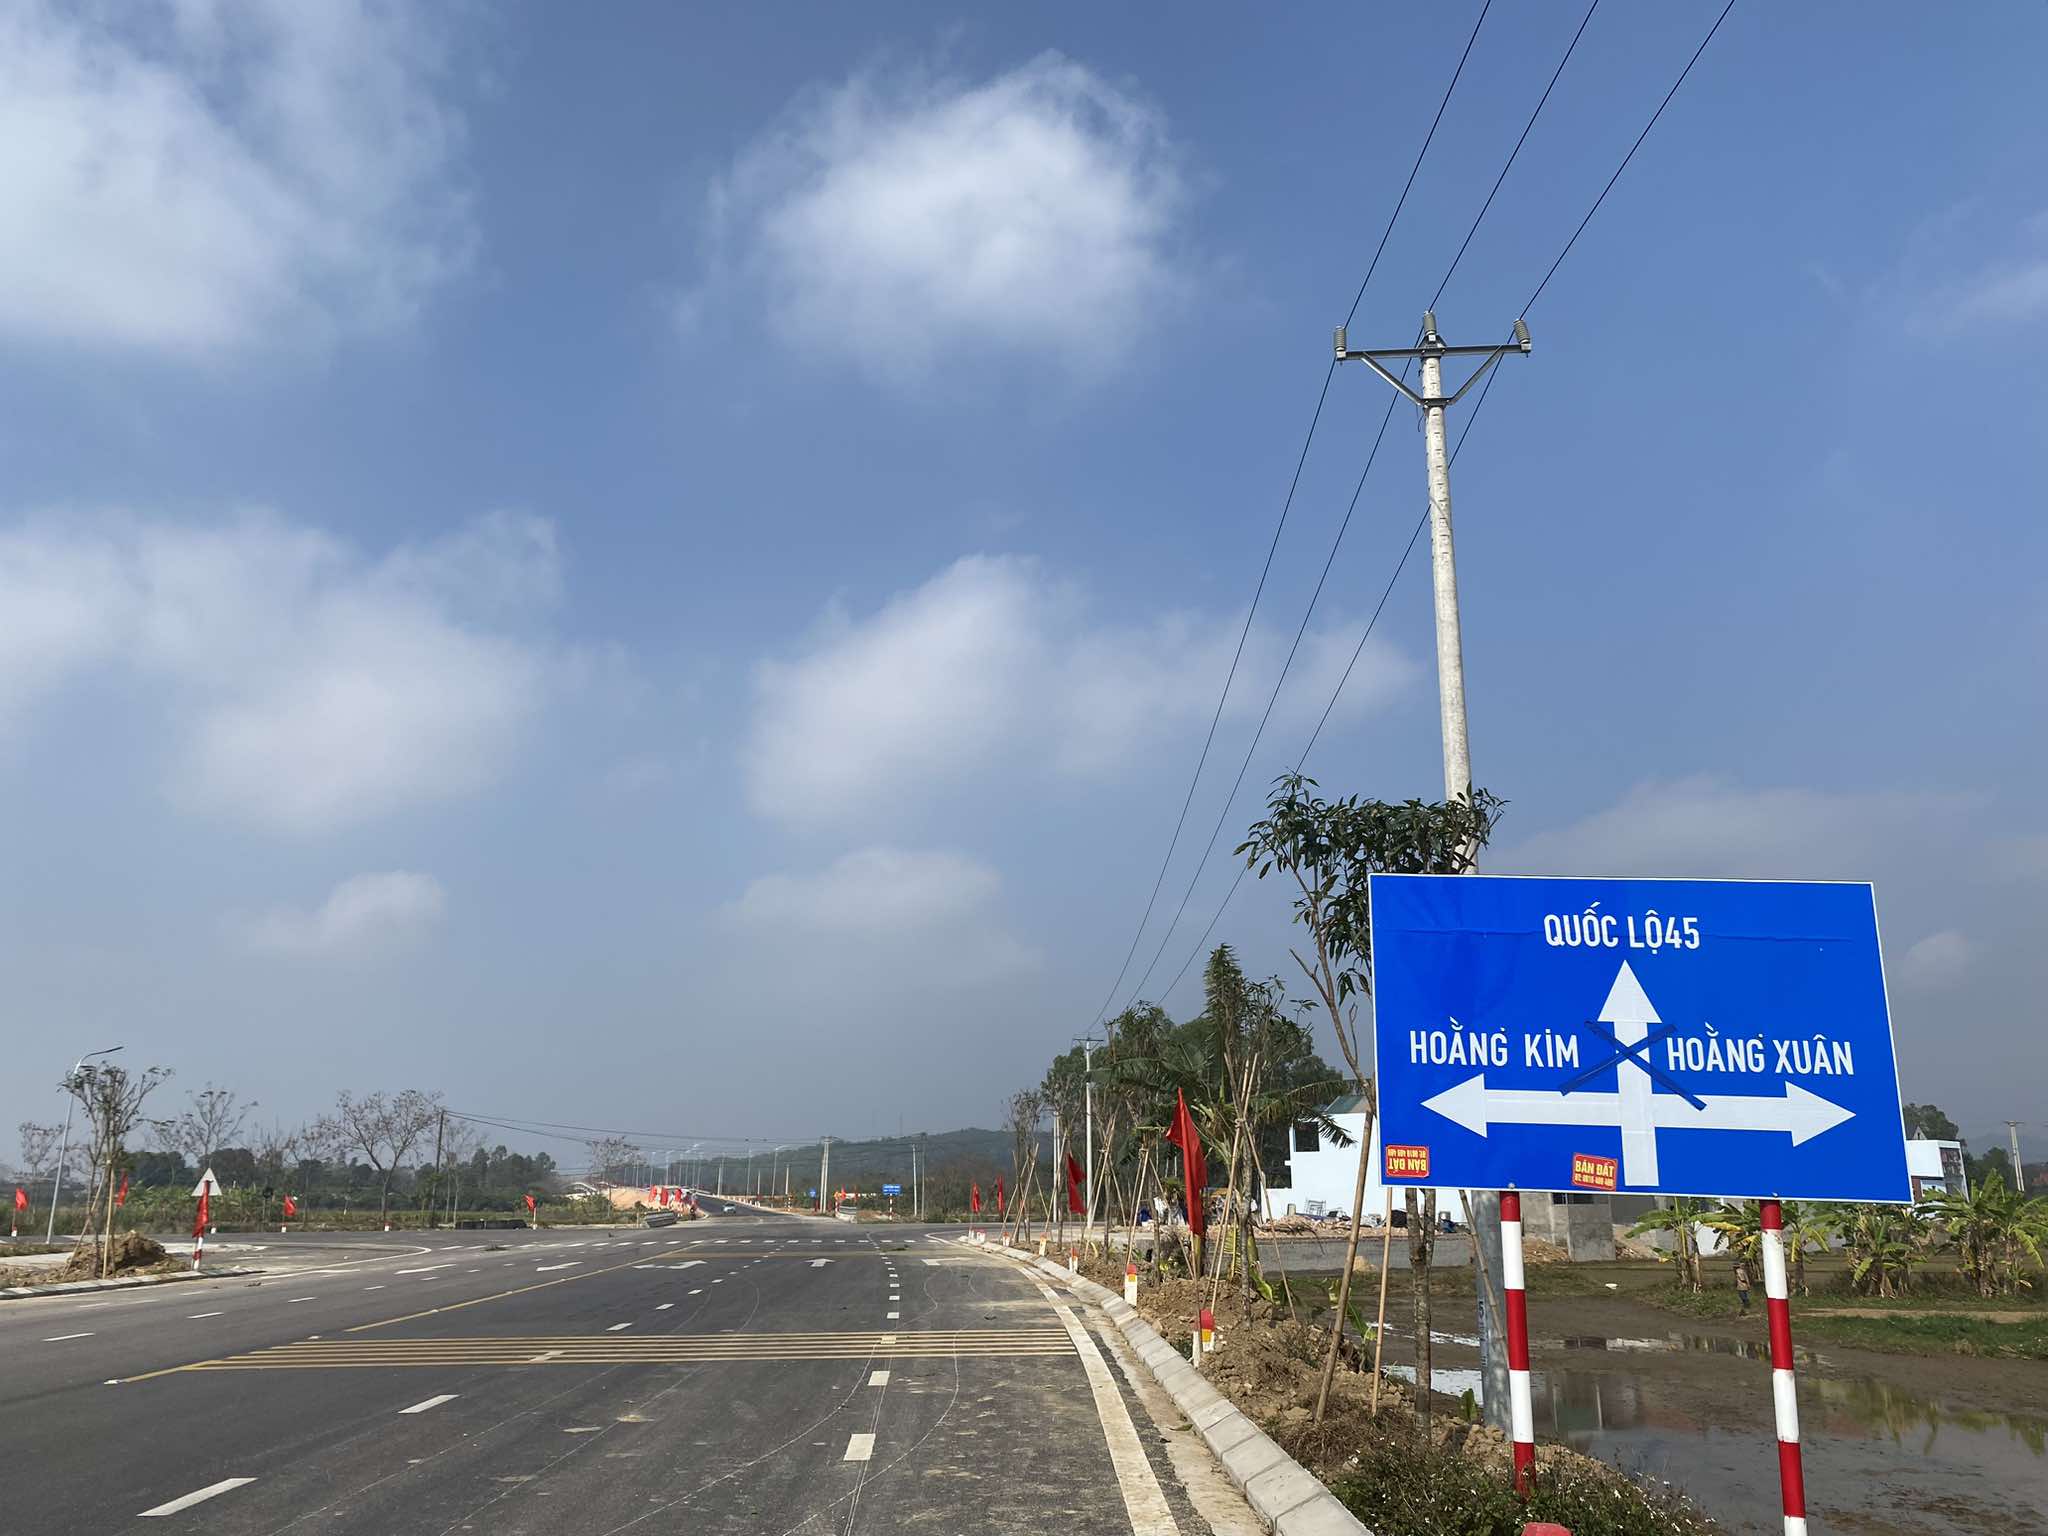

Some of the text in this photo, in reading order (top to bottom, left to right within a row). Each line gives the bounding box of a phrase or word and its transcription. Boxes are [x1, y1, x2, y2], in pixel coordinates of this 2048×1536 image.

[1543, 901, 1700, 955] QUỐC LỘ45
[1409, 1015, 1509, 1067] HOẰNG
[1666, 1021, 1855, 1076] HOẰNG XUÂN
[1575, 1159, 1595, 1174] BÁN
